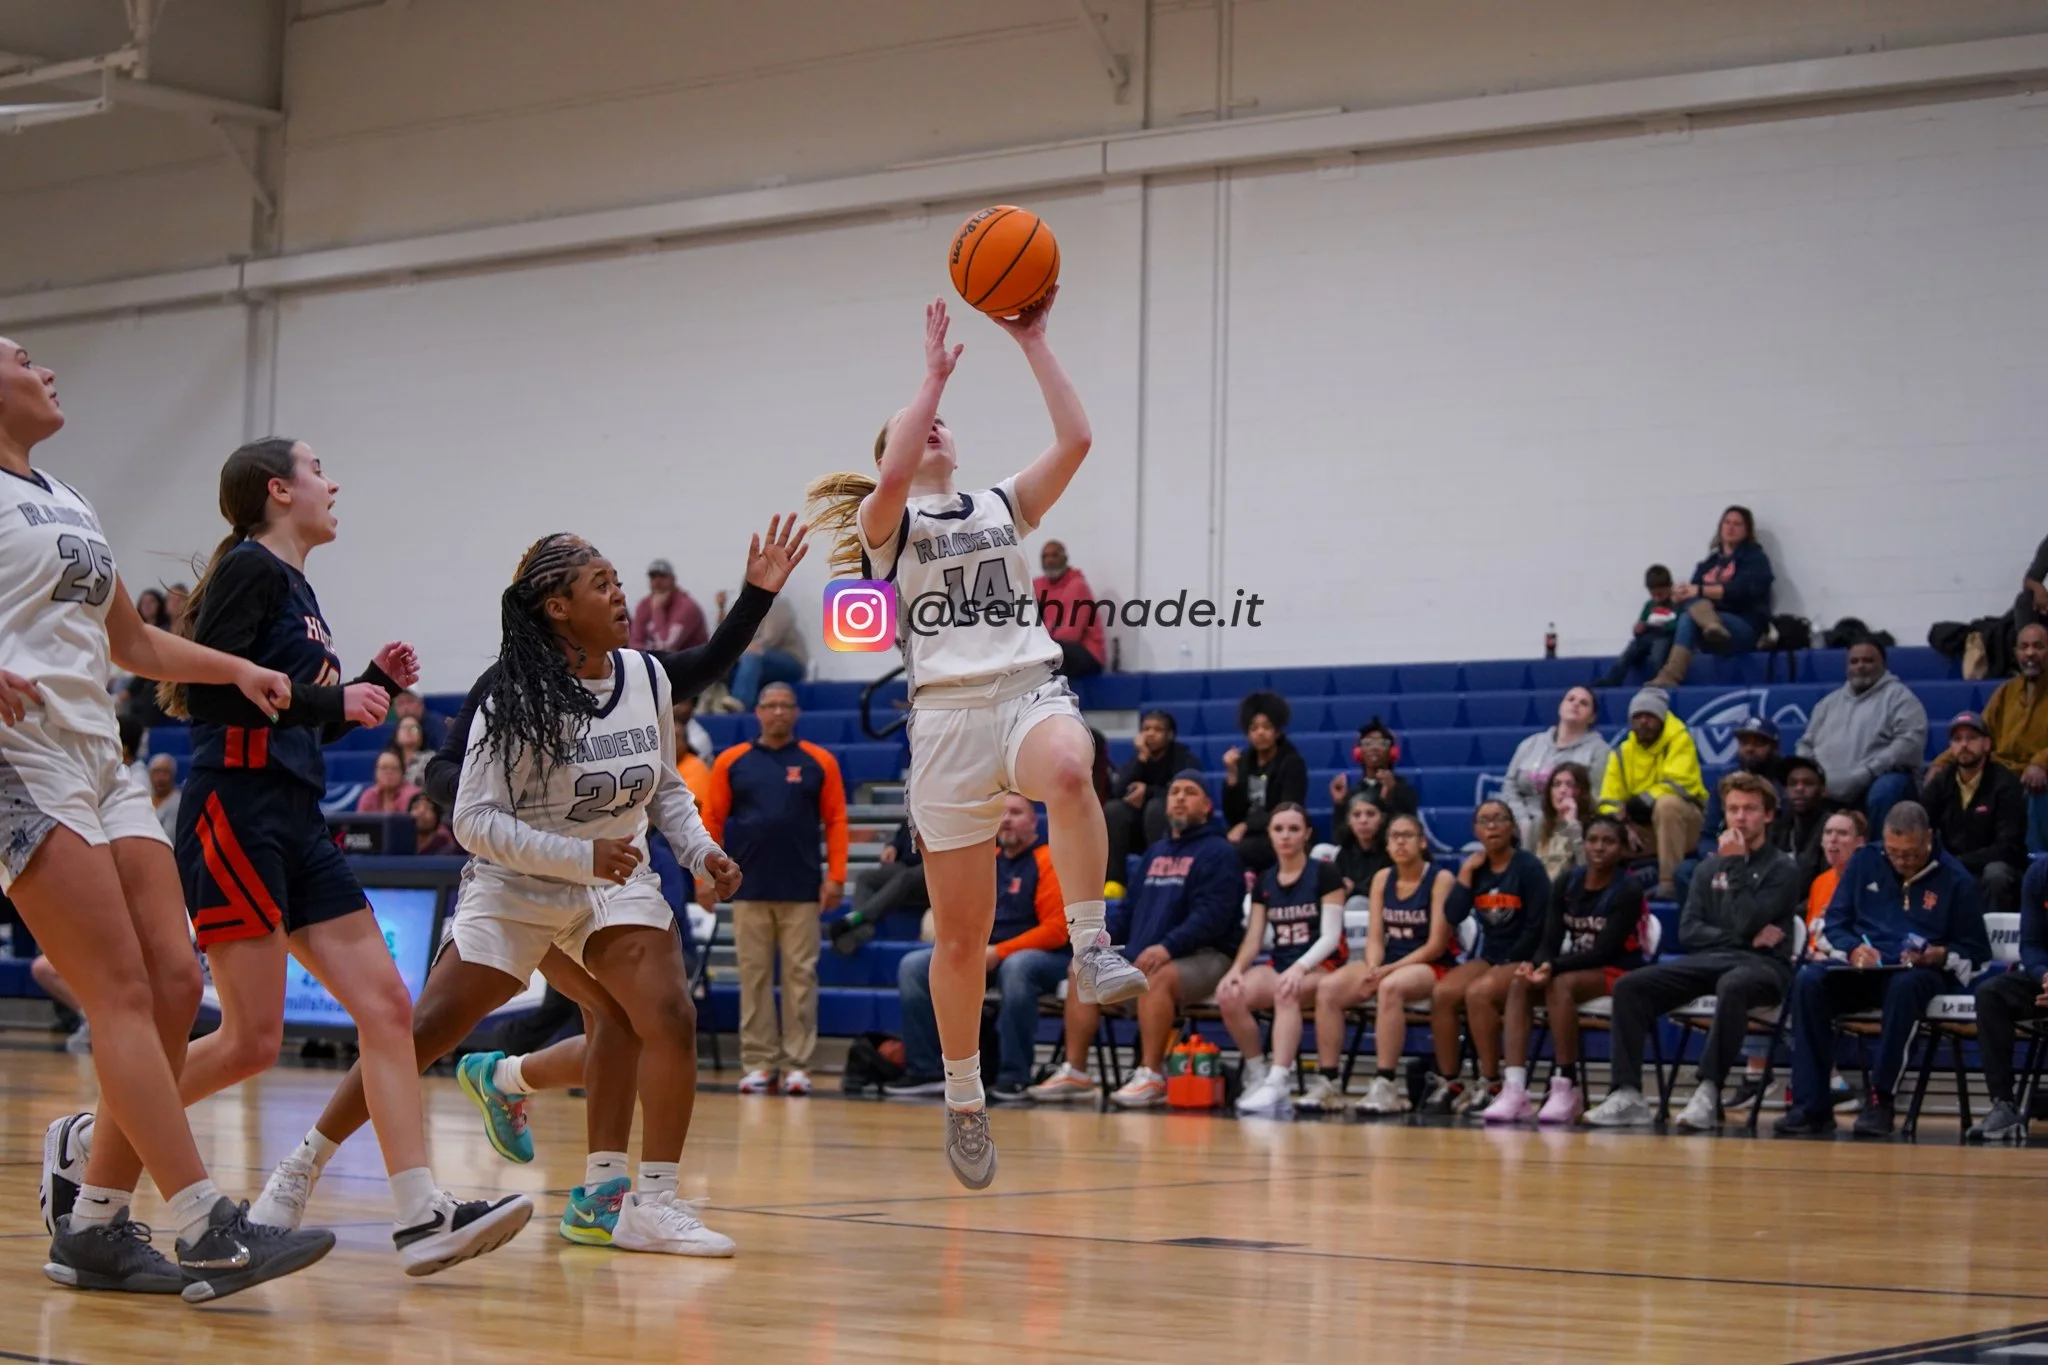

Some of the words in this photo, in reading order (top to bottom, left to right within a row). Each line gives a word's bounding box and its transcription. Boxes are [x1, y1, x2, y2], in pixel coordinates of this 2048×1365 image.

[51, 533, 114, 607] 25
[913, 524, 1018, 565] RAIDERS
[943, 557, 1015, 627] 14
[565, 764, 655, 823] 23
